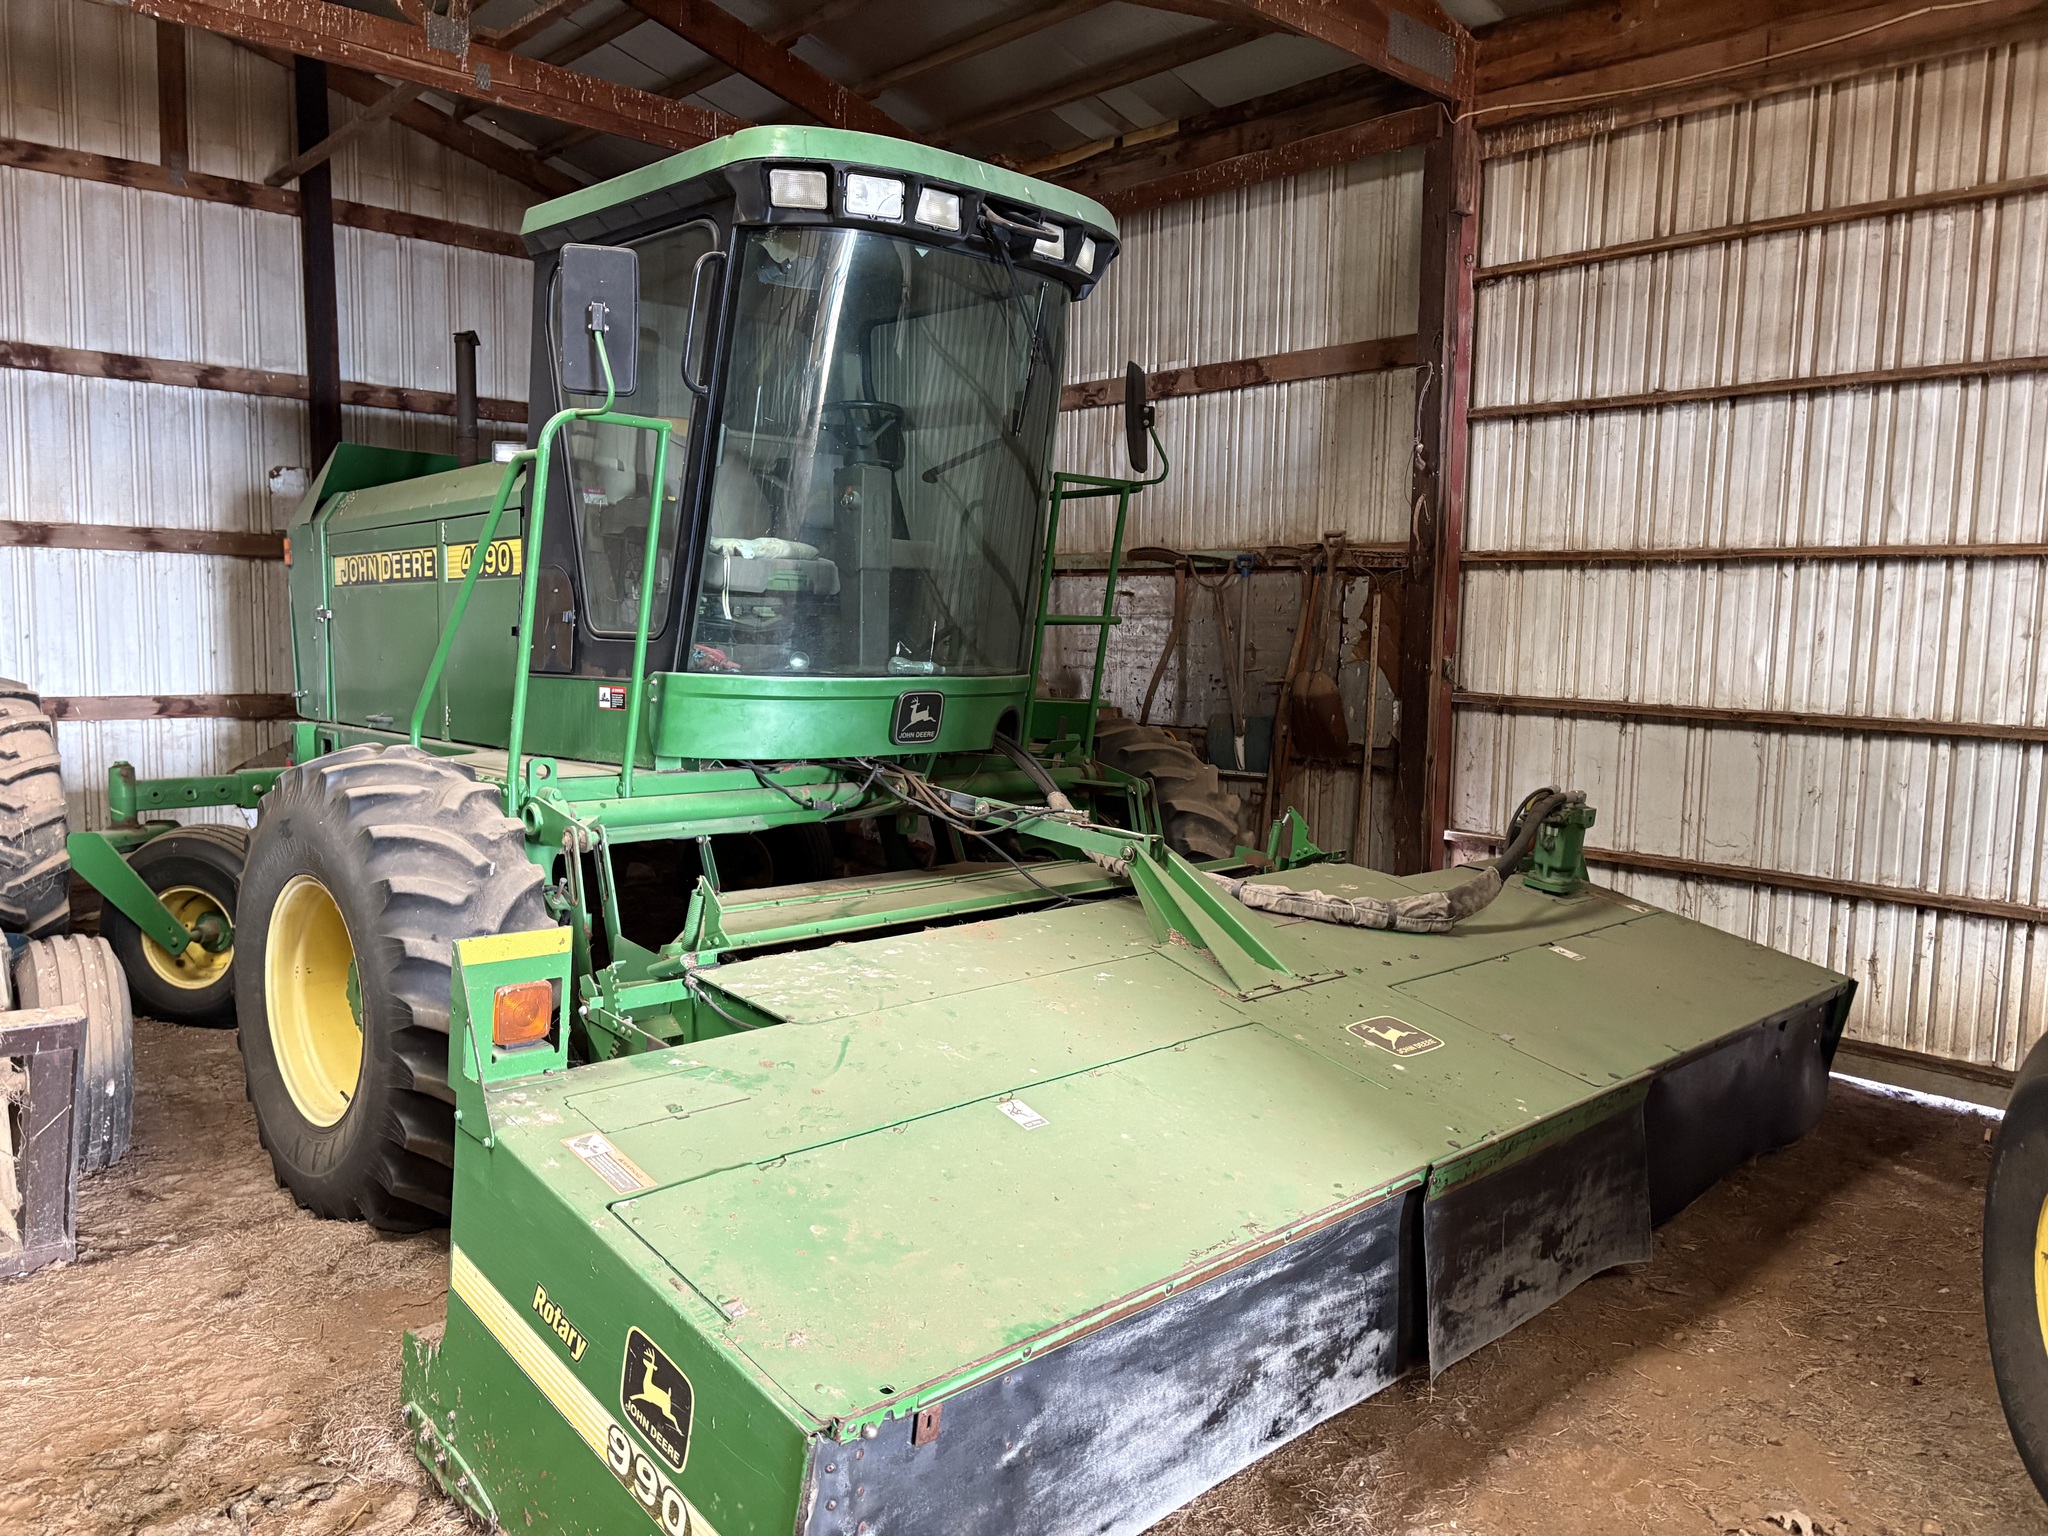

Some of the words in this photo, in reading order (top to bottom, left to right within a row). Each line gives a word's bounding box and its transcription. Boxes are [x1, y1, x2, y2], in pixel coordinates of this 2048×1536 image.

[341, 555, 379, 583] JOHN
[380, 549, 435, 581] DEERE
[461, 543, 512, 575] 490
[1397, 1044, 1416, 1054] JOHN
[1415, 1039, 1437, 1049] DEERE
[531, 1281, 589, 1364] Rotary
[624, 1399, 650, 1431] JOHN
[649, 1424, 682, 1465] DEERE
[607, 1424, 690, 1536] 990
